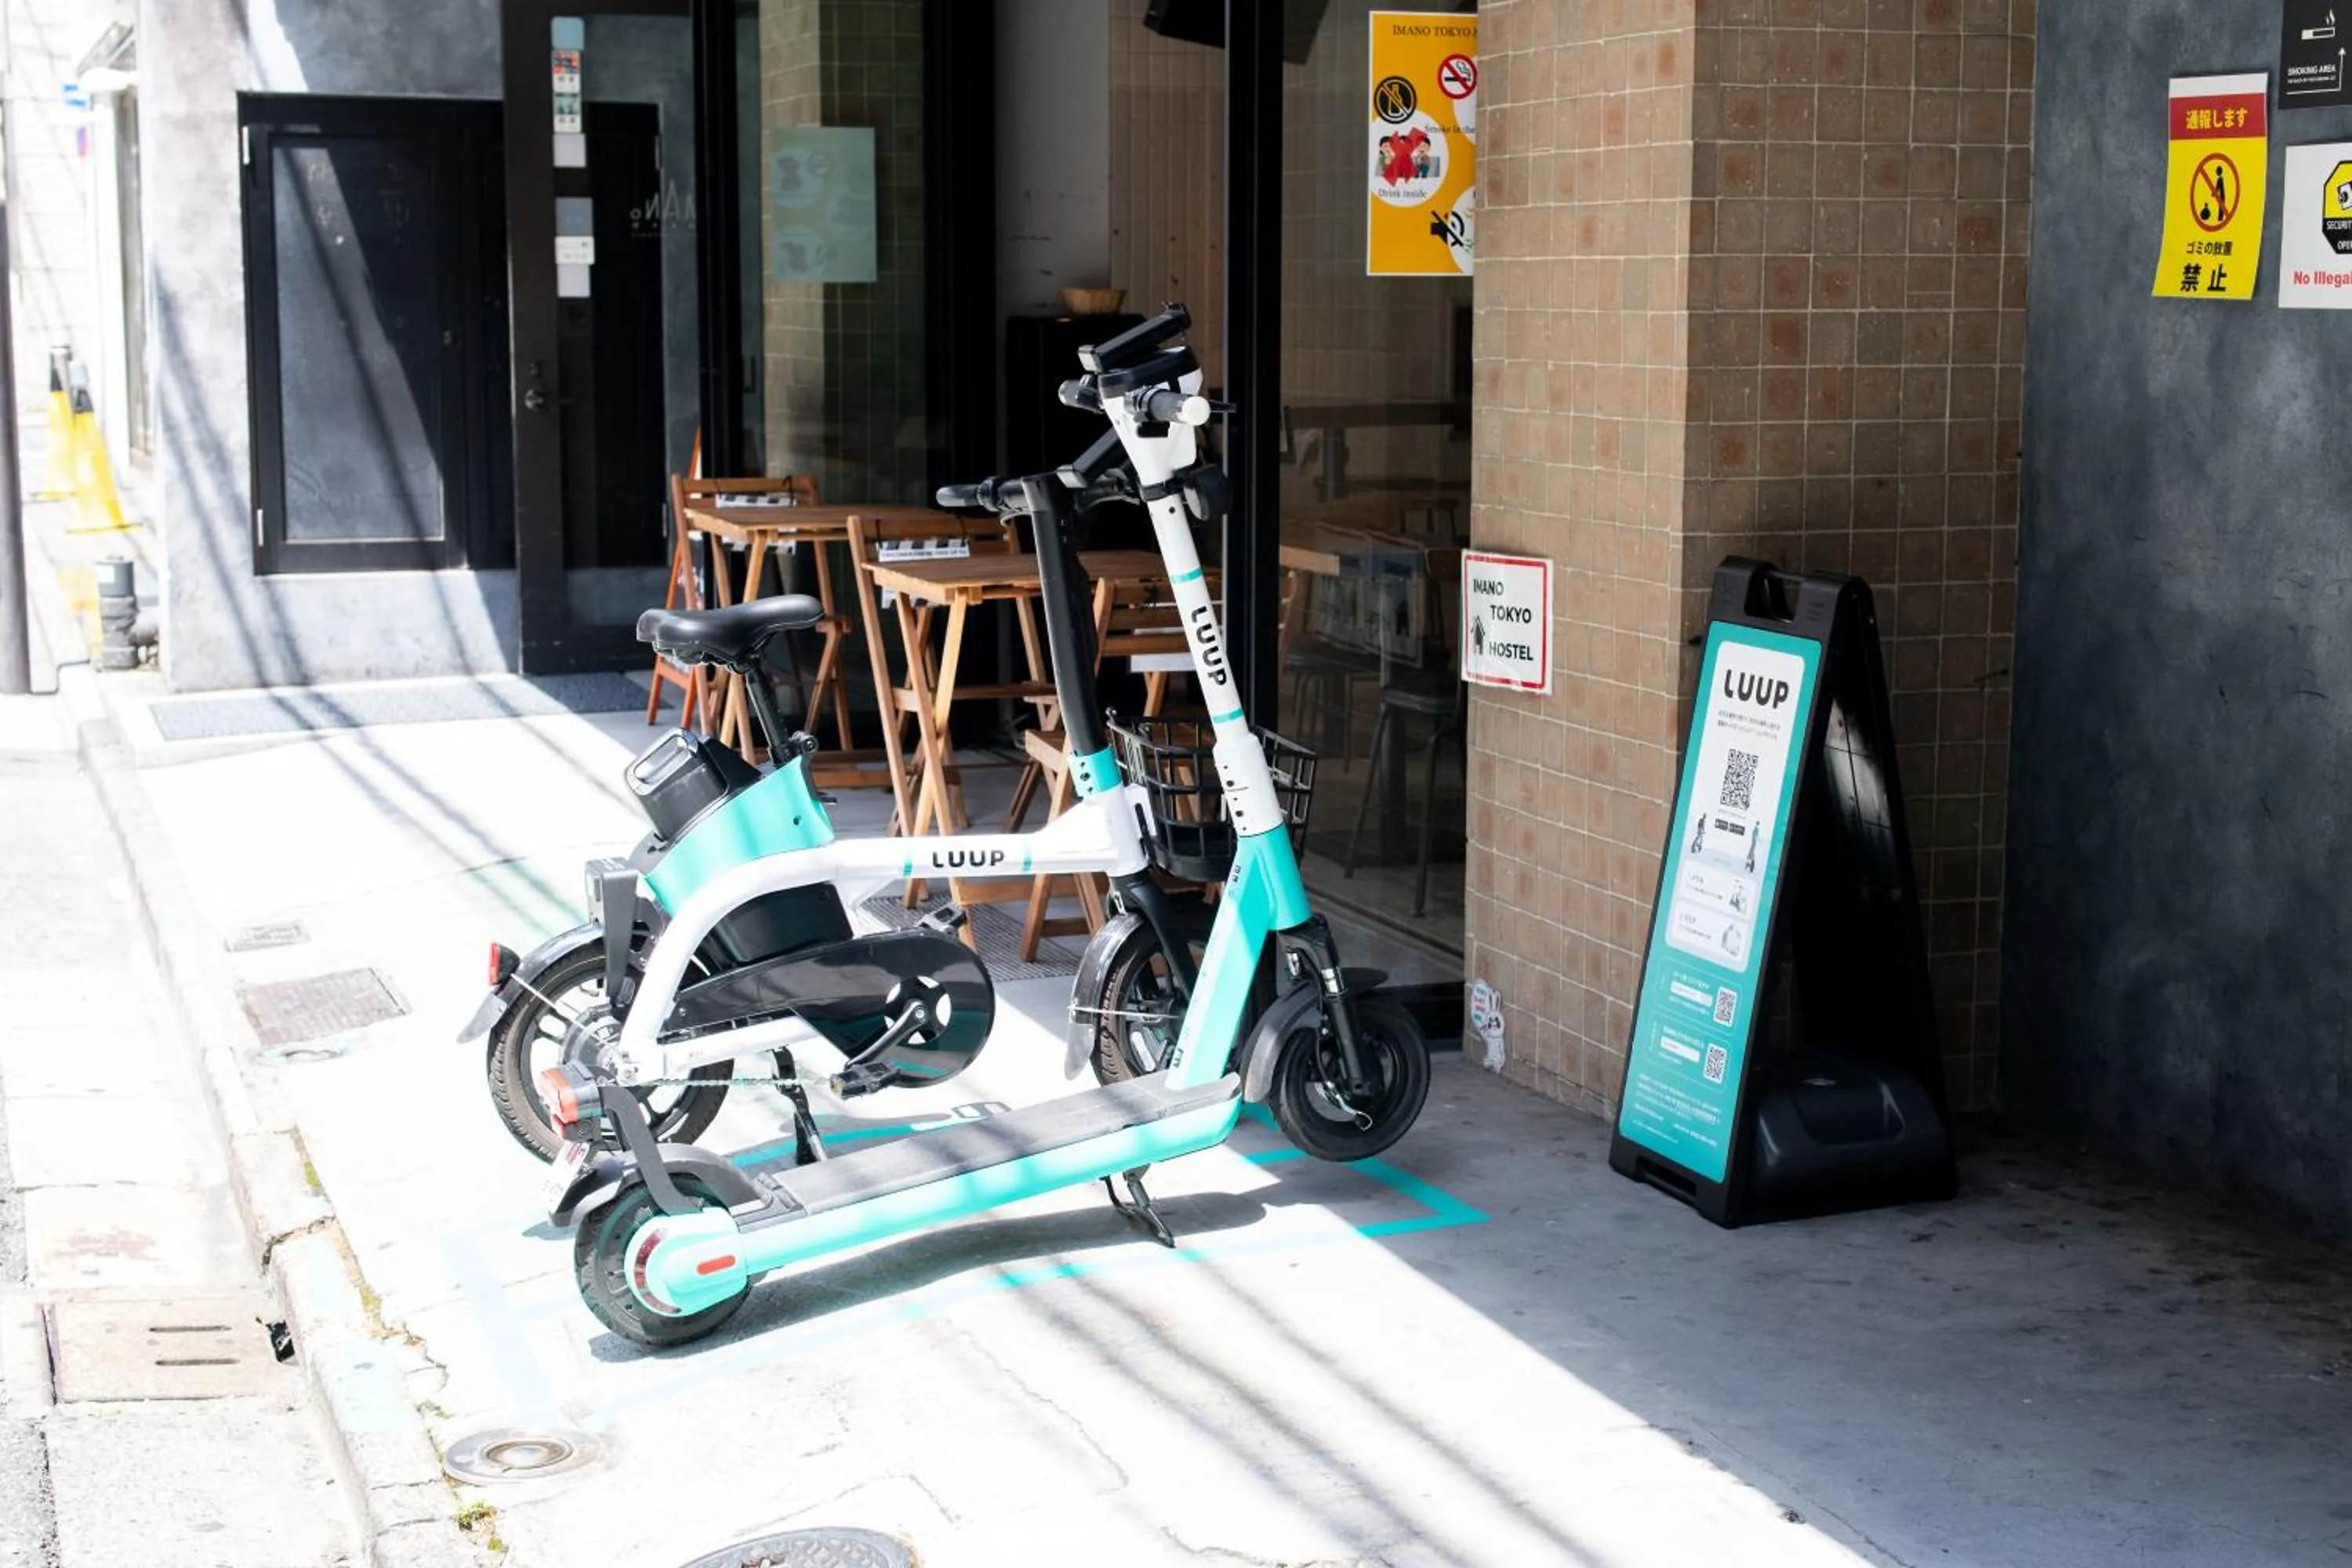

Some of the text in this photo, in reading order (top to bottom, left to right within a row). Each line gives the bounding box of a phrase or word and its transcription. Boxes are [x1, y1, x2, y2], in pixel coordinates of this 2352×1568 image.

[1392, 24, 1431, 37] IMANO
[1433, 26, 1472, 38] TOKYO
[2288, 64, 2336, 76] SMOKING AREA
[2186, 107, 2248, 130] 通報します
[2186, 241, 2233, 256] ゴミの放置
[2180, 263, 2227, 292] 禁止
[2294, 270, 2310, 285] No
[1473, 578, 1504, 597] IMANO
[1490, 604, 1532, 624] TOKYO
[1191, 605, 1227, 686] LUUP
[1489, 641, 1534, 661] HOSTEL
[1723, 669, 1789, 710] LUUP
[932, 850, 1004, 868] LUUP
